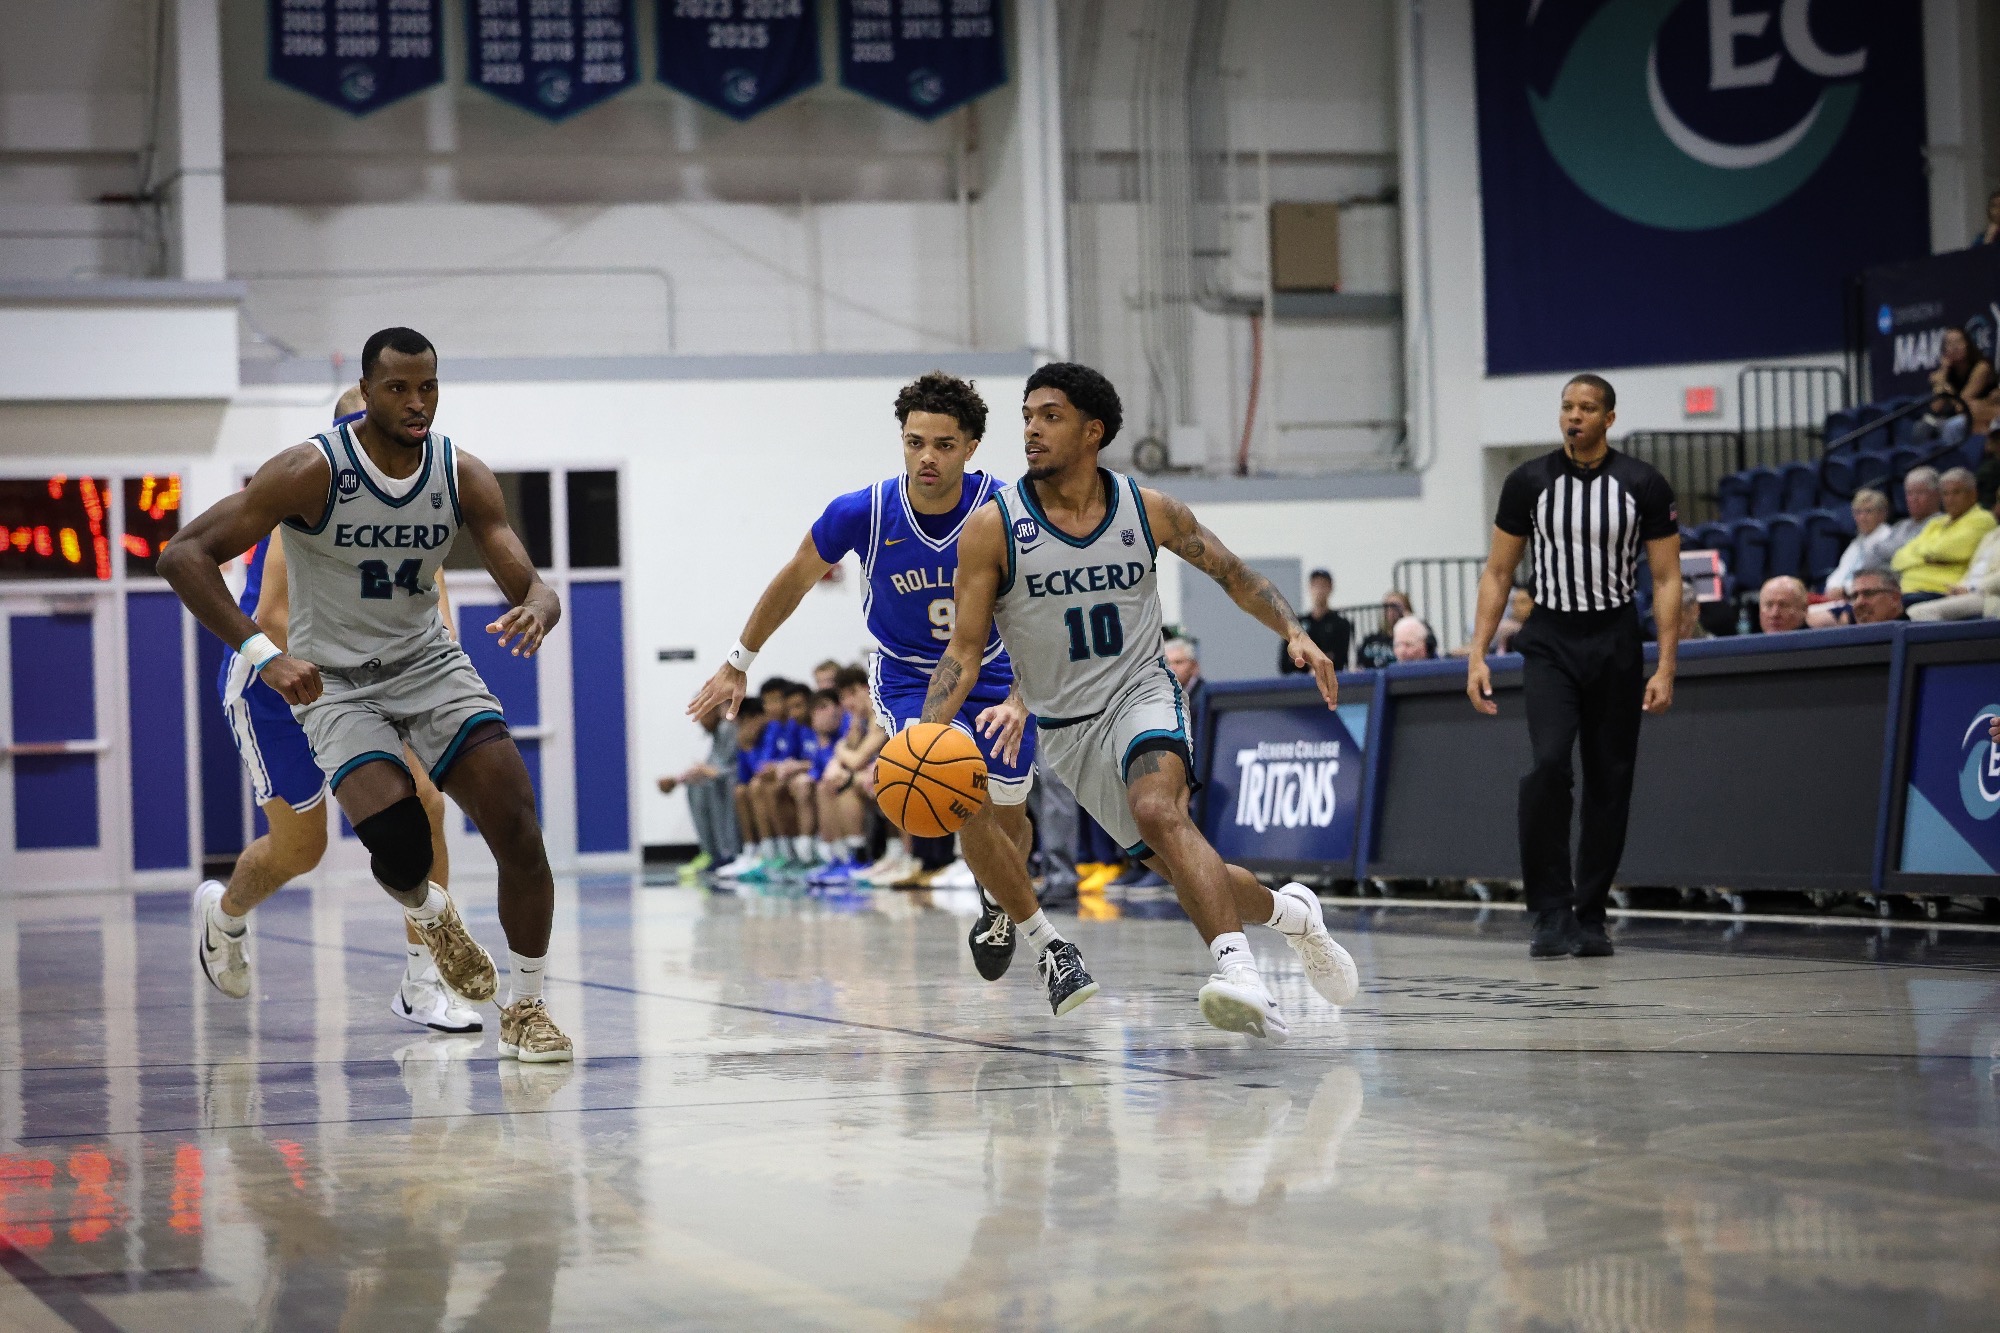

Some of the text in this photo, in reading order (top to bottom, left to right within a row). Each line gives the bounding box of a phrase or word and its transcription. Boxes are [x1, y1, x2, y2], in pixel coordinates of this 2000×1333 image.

[339, 474, 357, 488] JRH
[334, 524, 449, 550] ECKERD
[1016, 521, 1036, 538] JRH
[358, 559, 425, 599] 24
[1025, 561, 1145, 598] ECKERD
[928, 598, 956, 640] 9
[1064, 602, 1124, 662] 10
[1235, 749, 1339, 833] TRITONS
